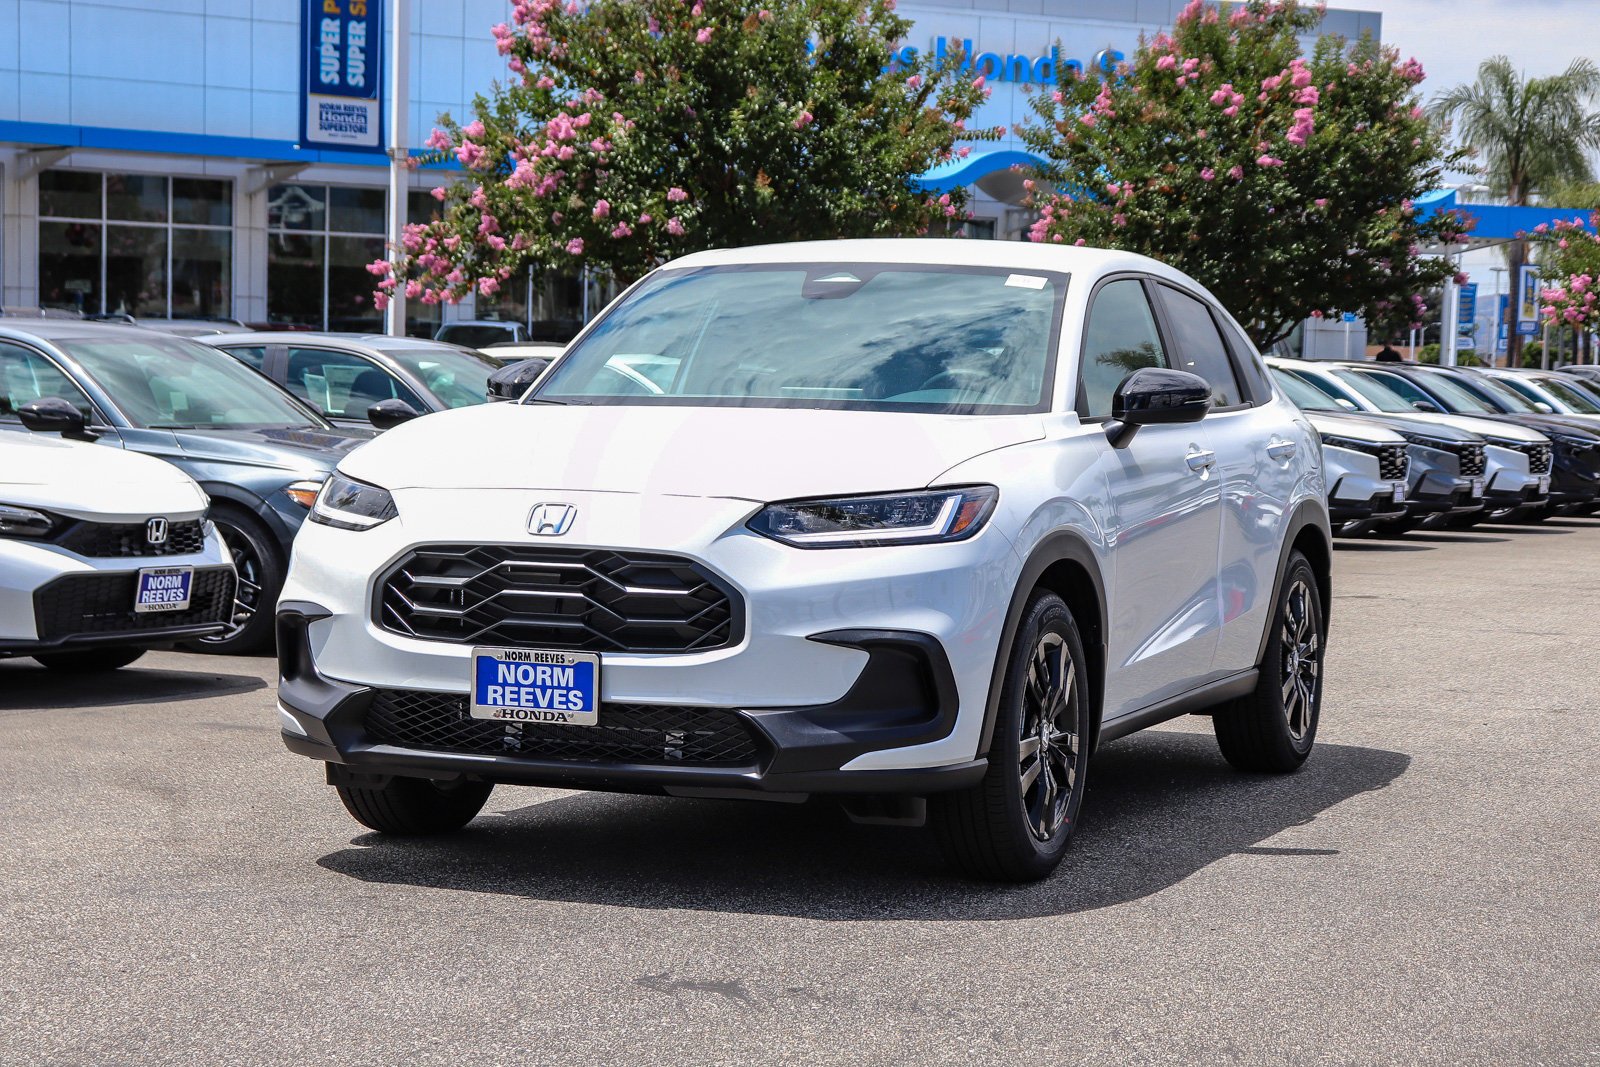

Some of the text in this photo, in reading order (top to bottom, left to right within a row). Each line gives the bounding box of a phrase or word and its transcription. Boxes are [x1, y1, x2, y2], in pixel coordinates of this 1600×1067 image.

[321, 18, 340, 85] SUPER
[346, 20, 366, 87] SUPER
[322, 110, 366, 124] Honda
[319, 121, 367, 134] SUPERSTORE
[147, 576, 182, 589] NORM
[142, 589, 184, 603] REEVES
[147, 603, 177, 611] HONDA
[504, 651, 565, 664] NORM REEVES
[498, 664, 574, 688] NORM
[487, 685, 584, 711] REEVES
[500, 709, 569, 722] HONDA
